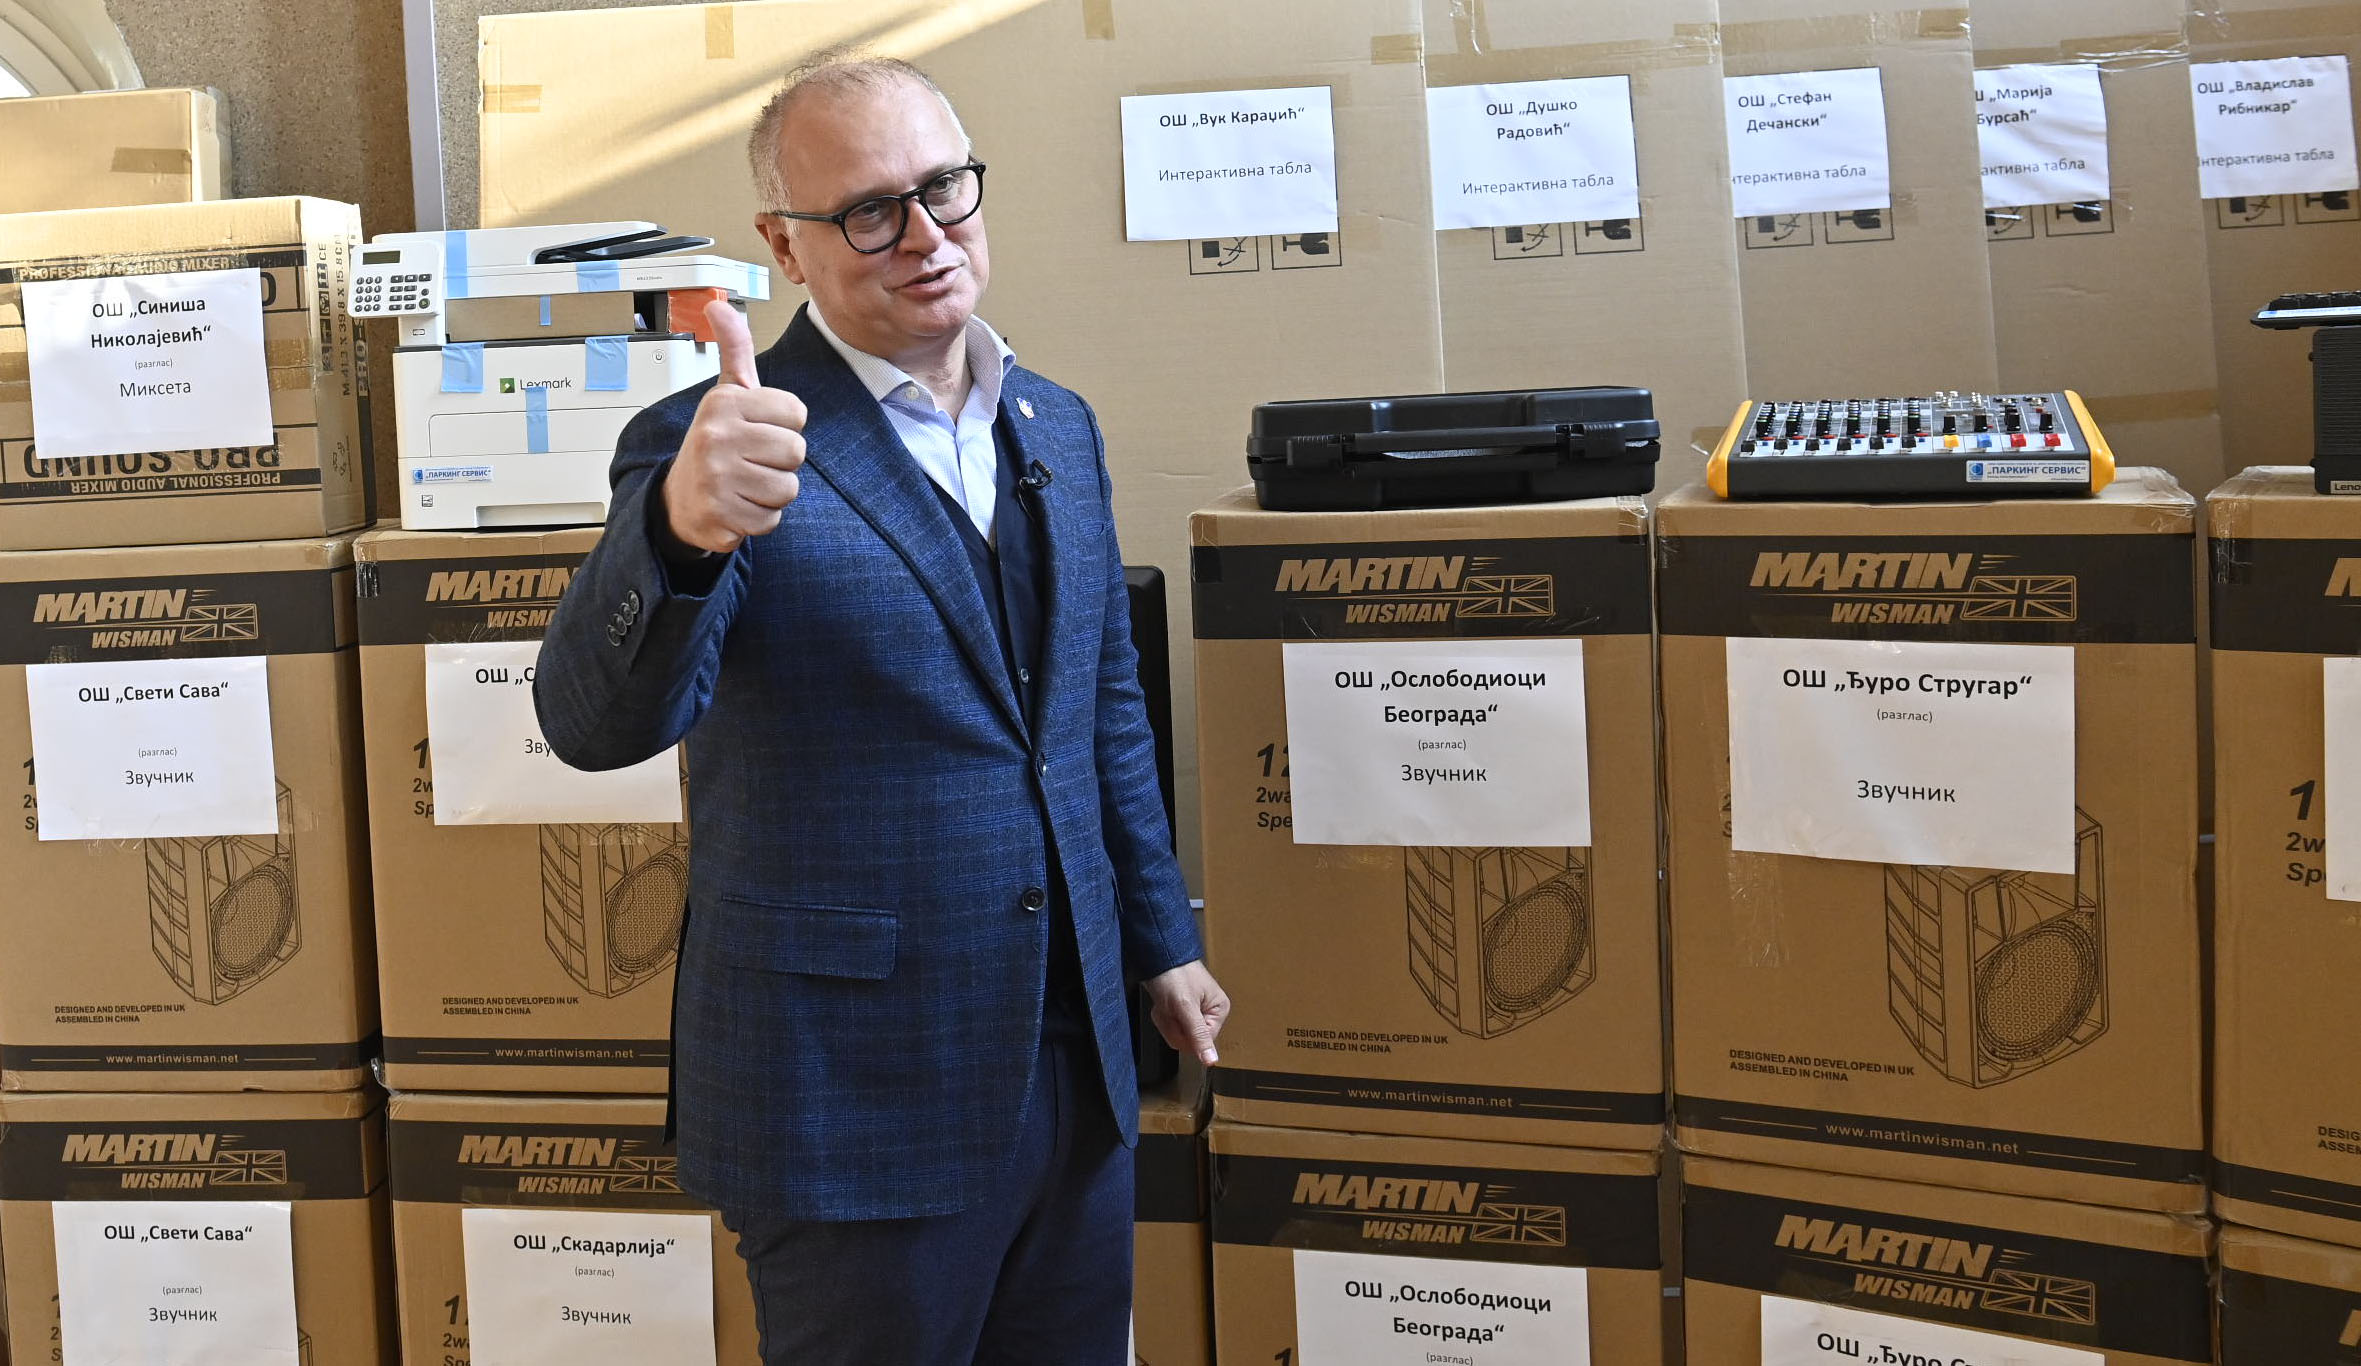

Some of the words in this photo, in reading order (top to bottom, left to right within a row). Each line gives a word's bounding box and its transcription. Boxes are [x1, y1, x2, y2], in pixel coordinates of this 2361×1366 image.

[1988, 84, 2053, 104] „Марија
[2197, 81, 2225, 95] ОШ
[2228, 78, 2315, 94] „Владислав
[1486, 102, 1514, 116] ОШ
[1518, 101, 1578, 116] „Душко
[1737, 94, 1765, 108] ОШ
[1769, 91, 1832, 108] „Стефан
[1159, 113, 1187, 128] ОШ
[1192, 113, 1227, 128] „Вук
[1231, 107, 1305, 125] Караџић“
[1746, 113, 1827, 134] Дечански“
[1496, 122, 1570, 141] Радовић“
[1981, 162, 2039, 176] активна
[2045, 158, 2086, 171] табла
[2200, 152, 2290, 168] нтерактивна
[2295, 148, 2335, 161] табла
[1159, 166, 1265, 183] Интерактивна
[1268, 161, 1312, 176] табла
[1823, 164, 1867, 179] табла
[1462, 179, 1568, 196] Интерактивна
[1571, 173, 1614, 188] табла
[92, 302, 123, 318] ОШ
[129, 299, 206, 319] „Синиша
[91, 324, 211, 349] Николајевић“
[135, 358, 173, 369] (разглас)
[119, 382, 191, 398] Миксета
[520, 376, 572, 391] Lexmark
[71, 480, 117, 494] MIXER
[122, 478, 166, 491] AUDIO
[170, 472, 280, 489] PROFESSIONAL
[1274, 556, 1466, 594] MARTIN
[1750, 552, 1972, 592] MARTIN
[33, 589, 186, 624] MARTIN
[1346, 603, 1450, 624] WISMAN
[1831, 603, 1954, 624] WISMAN
[488, 610, 557, 628] WISM
[91, 630, 177, 649] WISMAN
[475, 667, 509, 684] ОШ
[1334, 671, 1373, 689] ОШ
[1380, 668, 1546, 692] „Ослободиоци
[1782, 668, 1826, 688] ОШ
[1834, 670, 1911, 695] „Ђуро
[1918, 673, 2032, 700] Стругар“
[78, 687, 110, 703] ОШ
[115, 686, 174, 705] „Свети
[179, 681, 229, 699] Сава“
[1384, 703, 1498, 727] Београда“
[1876, 709, 1934, 724] (разглас)
[138, 747, 178, 758] (разглас)
[1418, 739, 1468, 751] (разглас)
[125, 770, 194, 788] Звучник
[1401, 764, 1487, 786] Звучник
[1256, 786, 1291, 804] 2wa
[1857, 779, 1956, 804] Звучник
[54, 1006, 95, 1014] DESIGNED
[96, 1005, 113, 1014] AND
[115, 1004, 162, 1013] DEVELOPED
[163, 1004, 172, 1013] IN
[173, 1004, 185, 1012] UK
[442, 997, 485, 1005] DESIGNED
[486, 997, 504, 1005] AND
[55, 1016, 104, 1024] ASSEMBLED
[105, 1015, 113, 1023] IN
[114, 1015, 140, 1023] CHINA
[443, 1007, 493, 1015] ASSEMBLED
[494, 1007, 503, 1015] IN
[504, 1007, 531, 1015] CHINA
[1286, 1028, 1336, 1040] DESIGNED
[1337, 1030, 1359, 1041] AND
[1360, 1032, 1418, 1044] DEVELOPED
[1421, 1034, 1432, 1044] IN
[1434, 1035, 1448, 1045] UK
[495, 1048, 634, 1059] www.martinwisman.net
[1287, 1040, 1346, 1052] ASSEMBLED
[1348, 1042, 1358, 1052] IN
[1360, 1043, 1392, 1054] CHINA
[106, 1053, 239, 1065] www.martinwisman.net
[1730, 1049, 1786, 1066] DESIGNED
[1788, 1054, 1812, 1067] AND
[1814, 1056, 1882, 1074] DEVELOPED
[1884, 1064, 1896, 1074] IN
[1898, 1066, 1915, 1076] UK
[1730, 1061, 1798, 1078] ASSEMBLED
[1799, 1067, 1810, 1079] IN
[1812, 1069, 1848, 1082] CHINA
[1348, 1088, 1513, 1108] www.martinwisman.net
[1826, 1122, 2019, 1155] www.martinwisman.net
[2318, 1126, 2361, 1141] DESIG
[62, 1134, 216, 1164] MARTIN
[457, 1135, 617, 1167] MARTIN
[121, 1172, 205, 1189] WISMAN
[518, 1176, 606, 1195] WISMAN
[1292, 1173, 1481, 1214] MARTIN
[104, 1225, 135, 1240] ОШ
[140, 1225, 199, 1243] „Свети
[203, 1225, 253, 1241] Сава“
[1362, 1220, 1465, 1244] WISMAN
[513, 1234, 546, 1250] ОШ
[551, 1235, 675, 1258] „Скадарлија“
[1774, 1214, 1994, 1278] MARTIN
[574, 1266, 615, 1278] (разглас)
[162, 1285, 202, 1295] (разглас)
[1344, 1280, 1383, 1299] ОШ
[1389, 1284, 1551, 1315] „Ослободиоци
[1854, 1274, 1976, 1310] WISMAN
[148, 1307, 218, 1324] Звучник
[561, 1305, 632, 1326] Звучник
[1393, 1316, 1505, 1345] Београда“
[1817, 1332, 1860, 1358] ОШ
